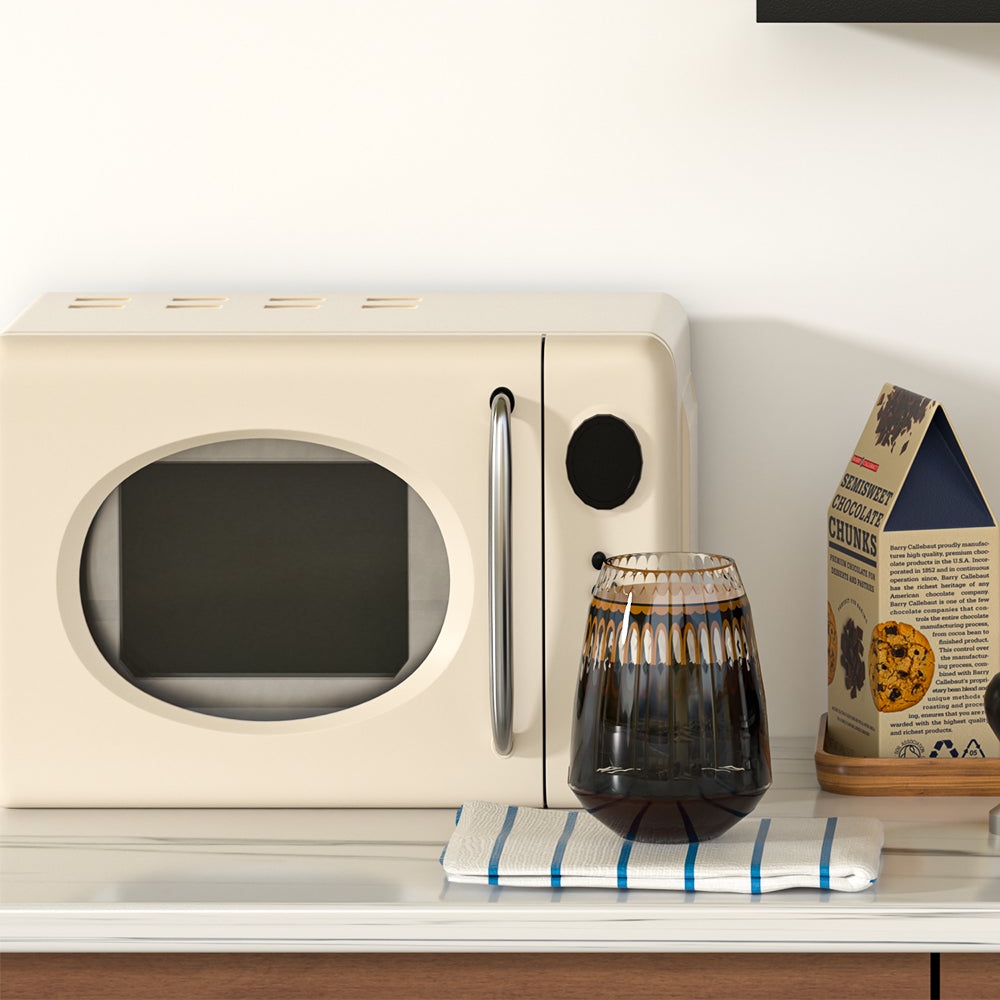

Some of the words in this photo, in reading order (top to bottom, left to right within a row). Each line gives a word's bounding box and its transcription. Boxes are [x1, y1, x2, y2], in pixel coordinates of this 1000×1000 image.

[840, 472, 894, 506] SEMISWEET
[831, 494, 884, 528] CHOCOLATE
[828, 515, 877, 558] CHUNKS
[937, 542, 961, 550] proudly
[889, 568, 914, 576] porated
